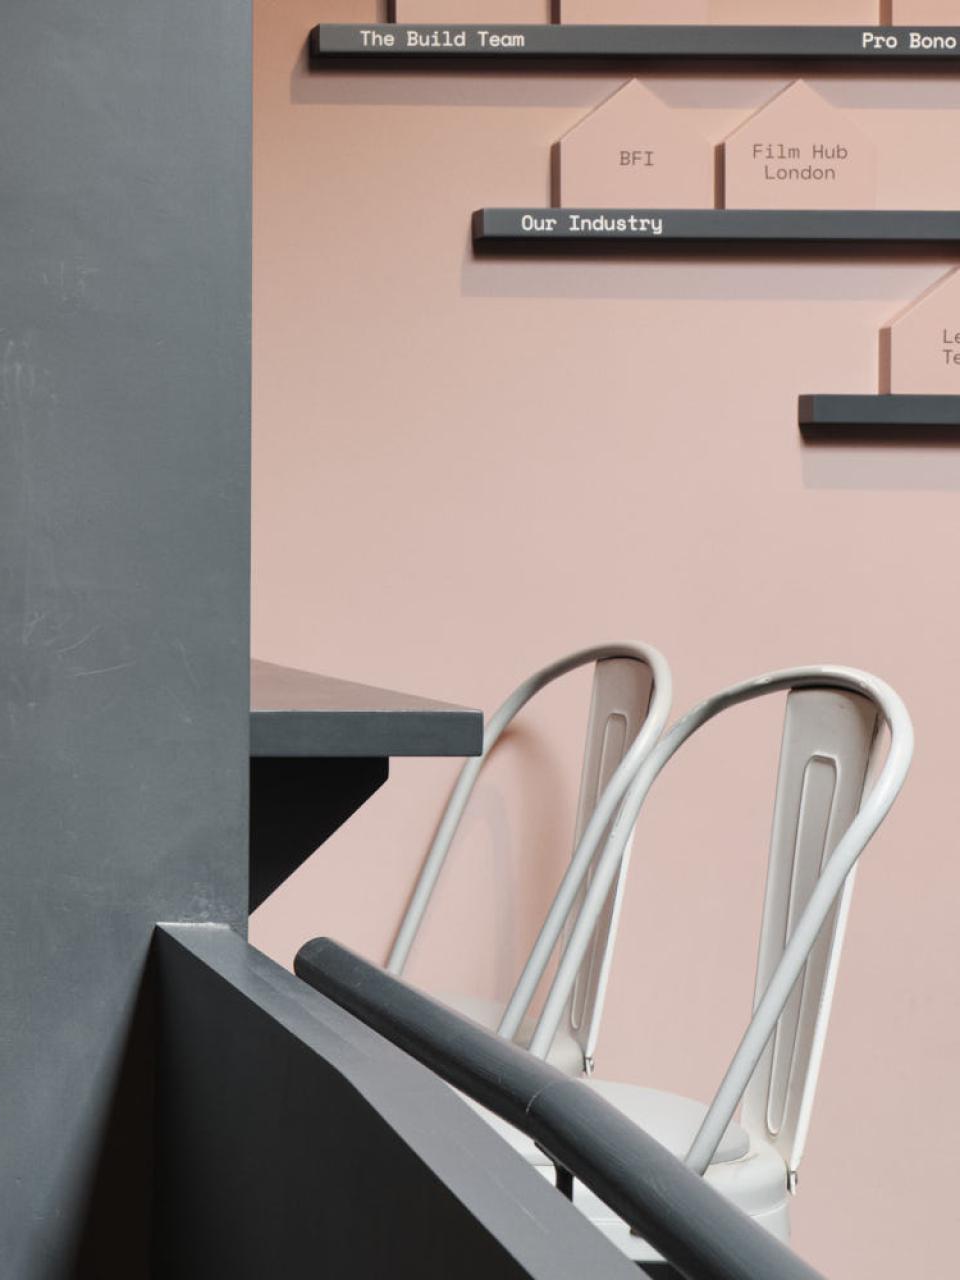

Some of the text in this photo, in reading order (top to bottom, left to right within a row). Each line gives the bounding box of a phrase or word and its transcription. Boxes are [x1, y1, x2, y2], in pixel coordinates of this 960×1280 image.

[359, 30, 525, 48] The Build Team
[862, 32, 957, 49] Pro Bono
[619, 150, 655, 167] BFI
[752, 143, 849, 160] Film Hub
[764, 164, 836, 181] London
[521, 214, 663, 235] Our Industry
